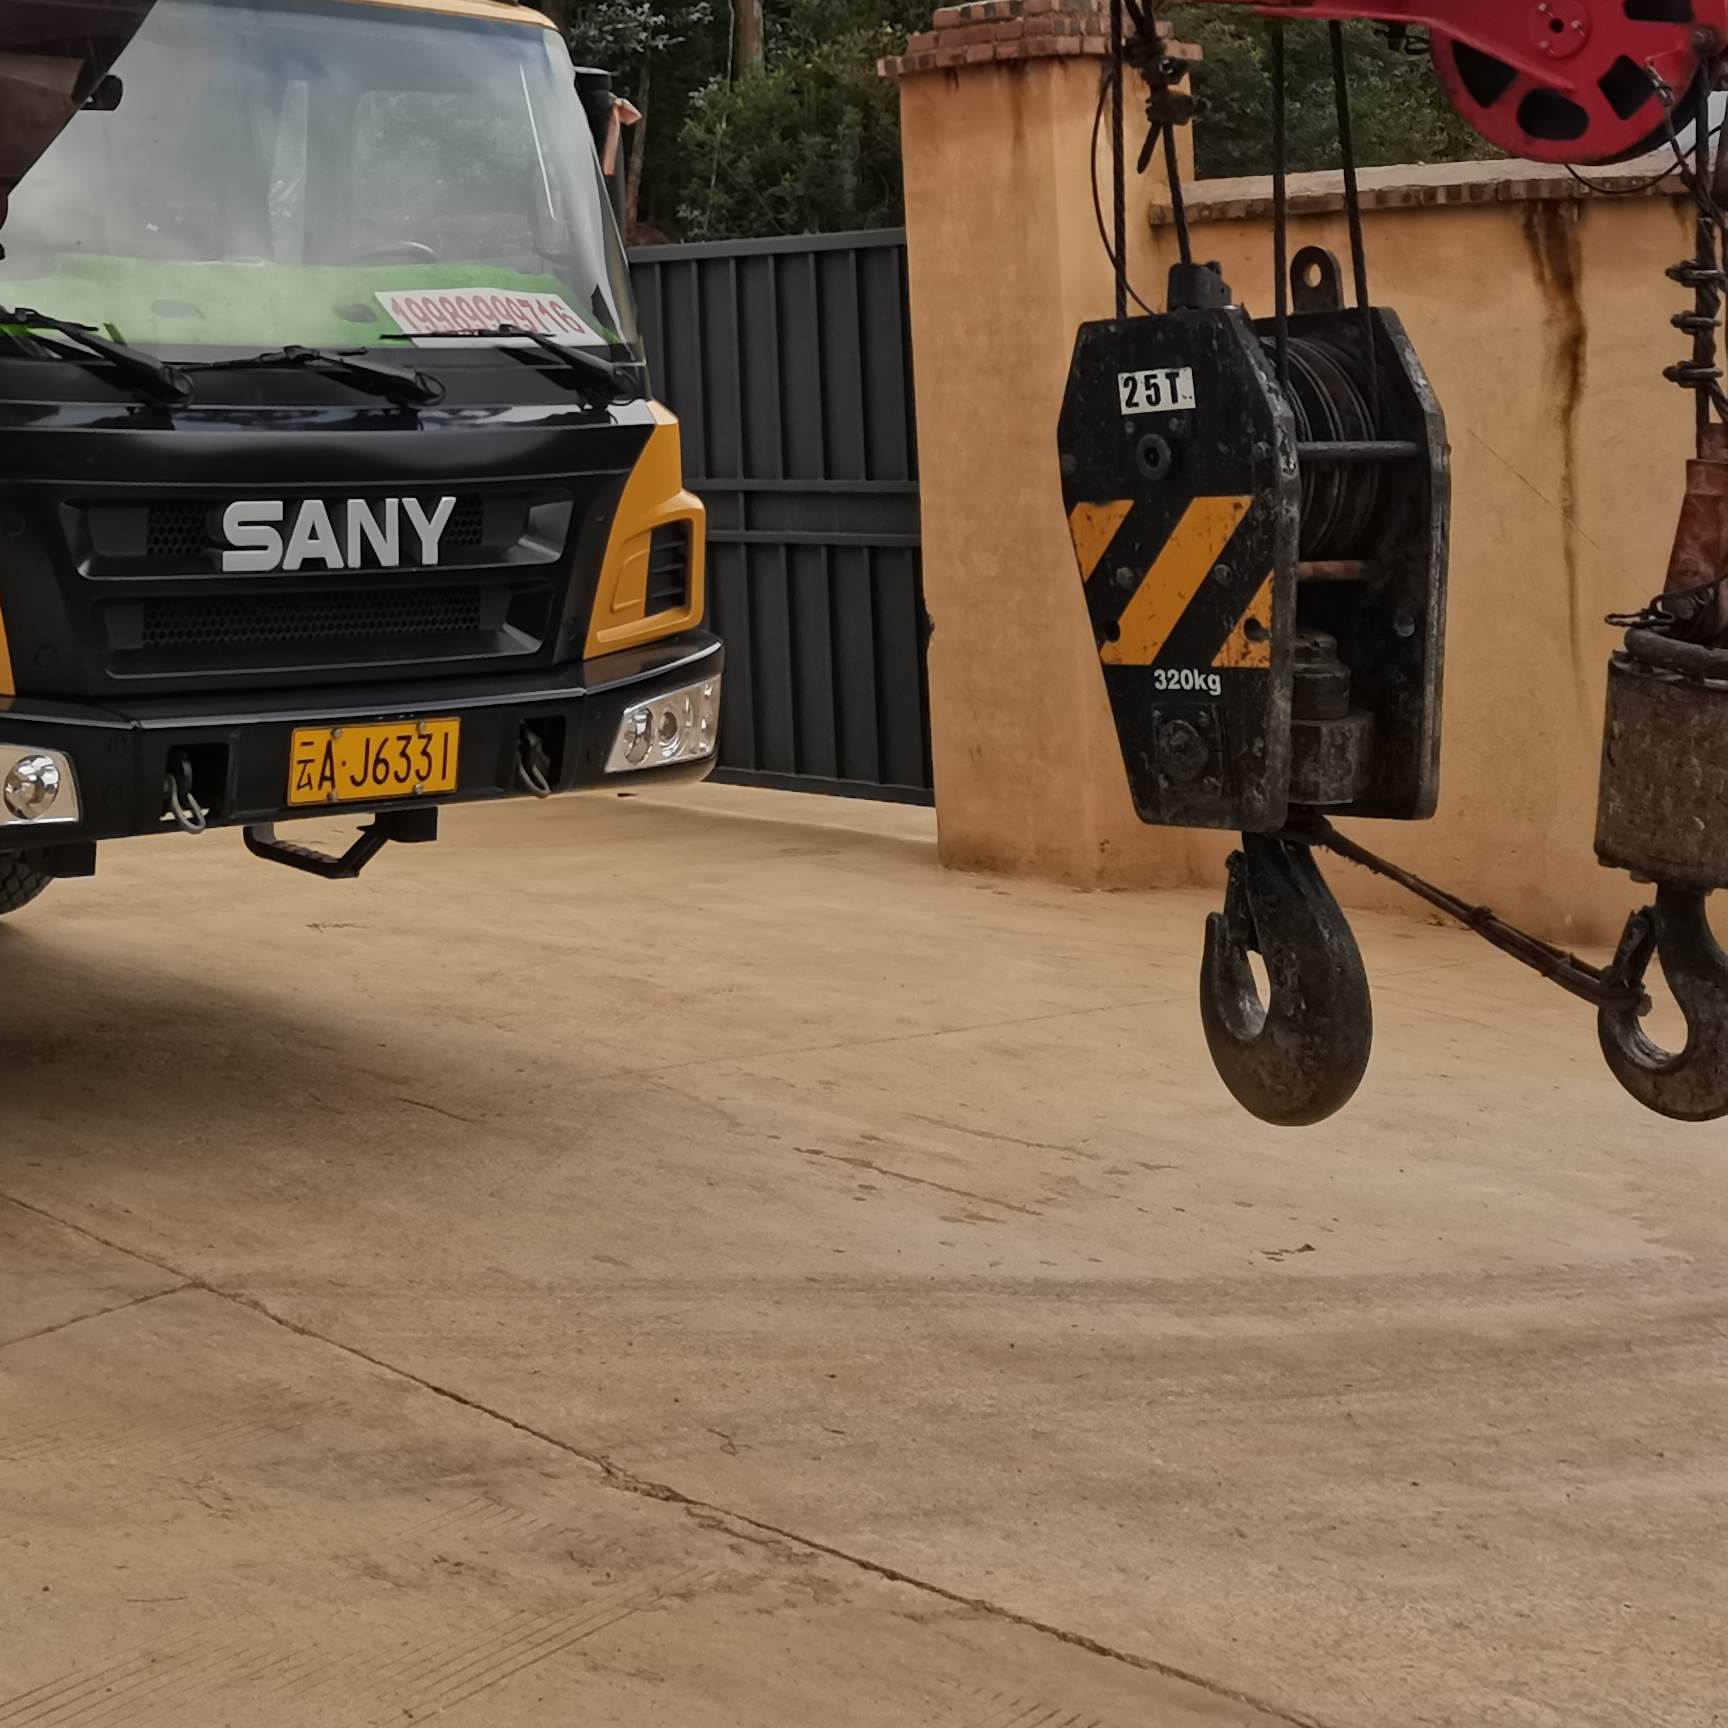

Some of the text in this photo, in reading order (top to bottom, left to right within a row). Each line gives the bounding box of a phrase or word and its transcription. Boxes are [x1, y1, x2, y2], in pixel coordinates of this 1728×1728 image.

[1122, 372, 1180, 409] 25T
[222, 496, 457, 572] SANY
[1153, 669, 1221, 697] 320kg
